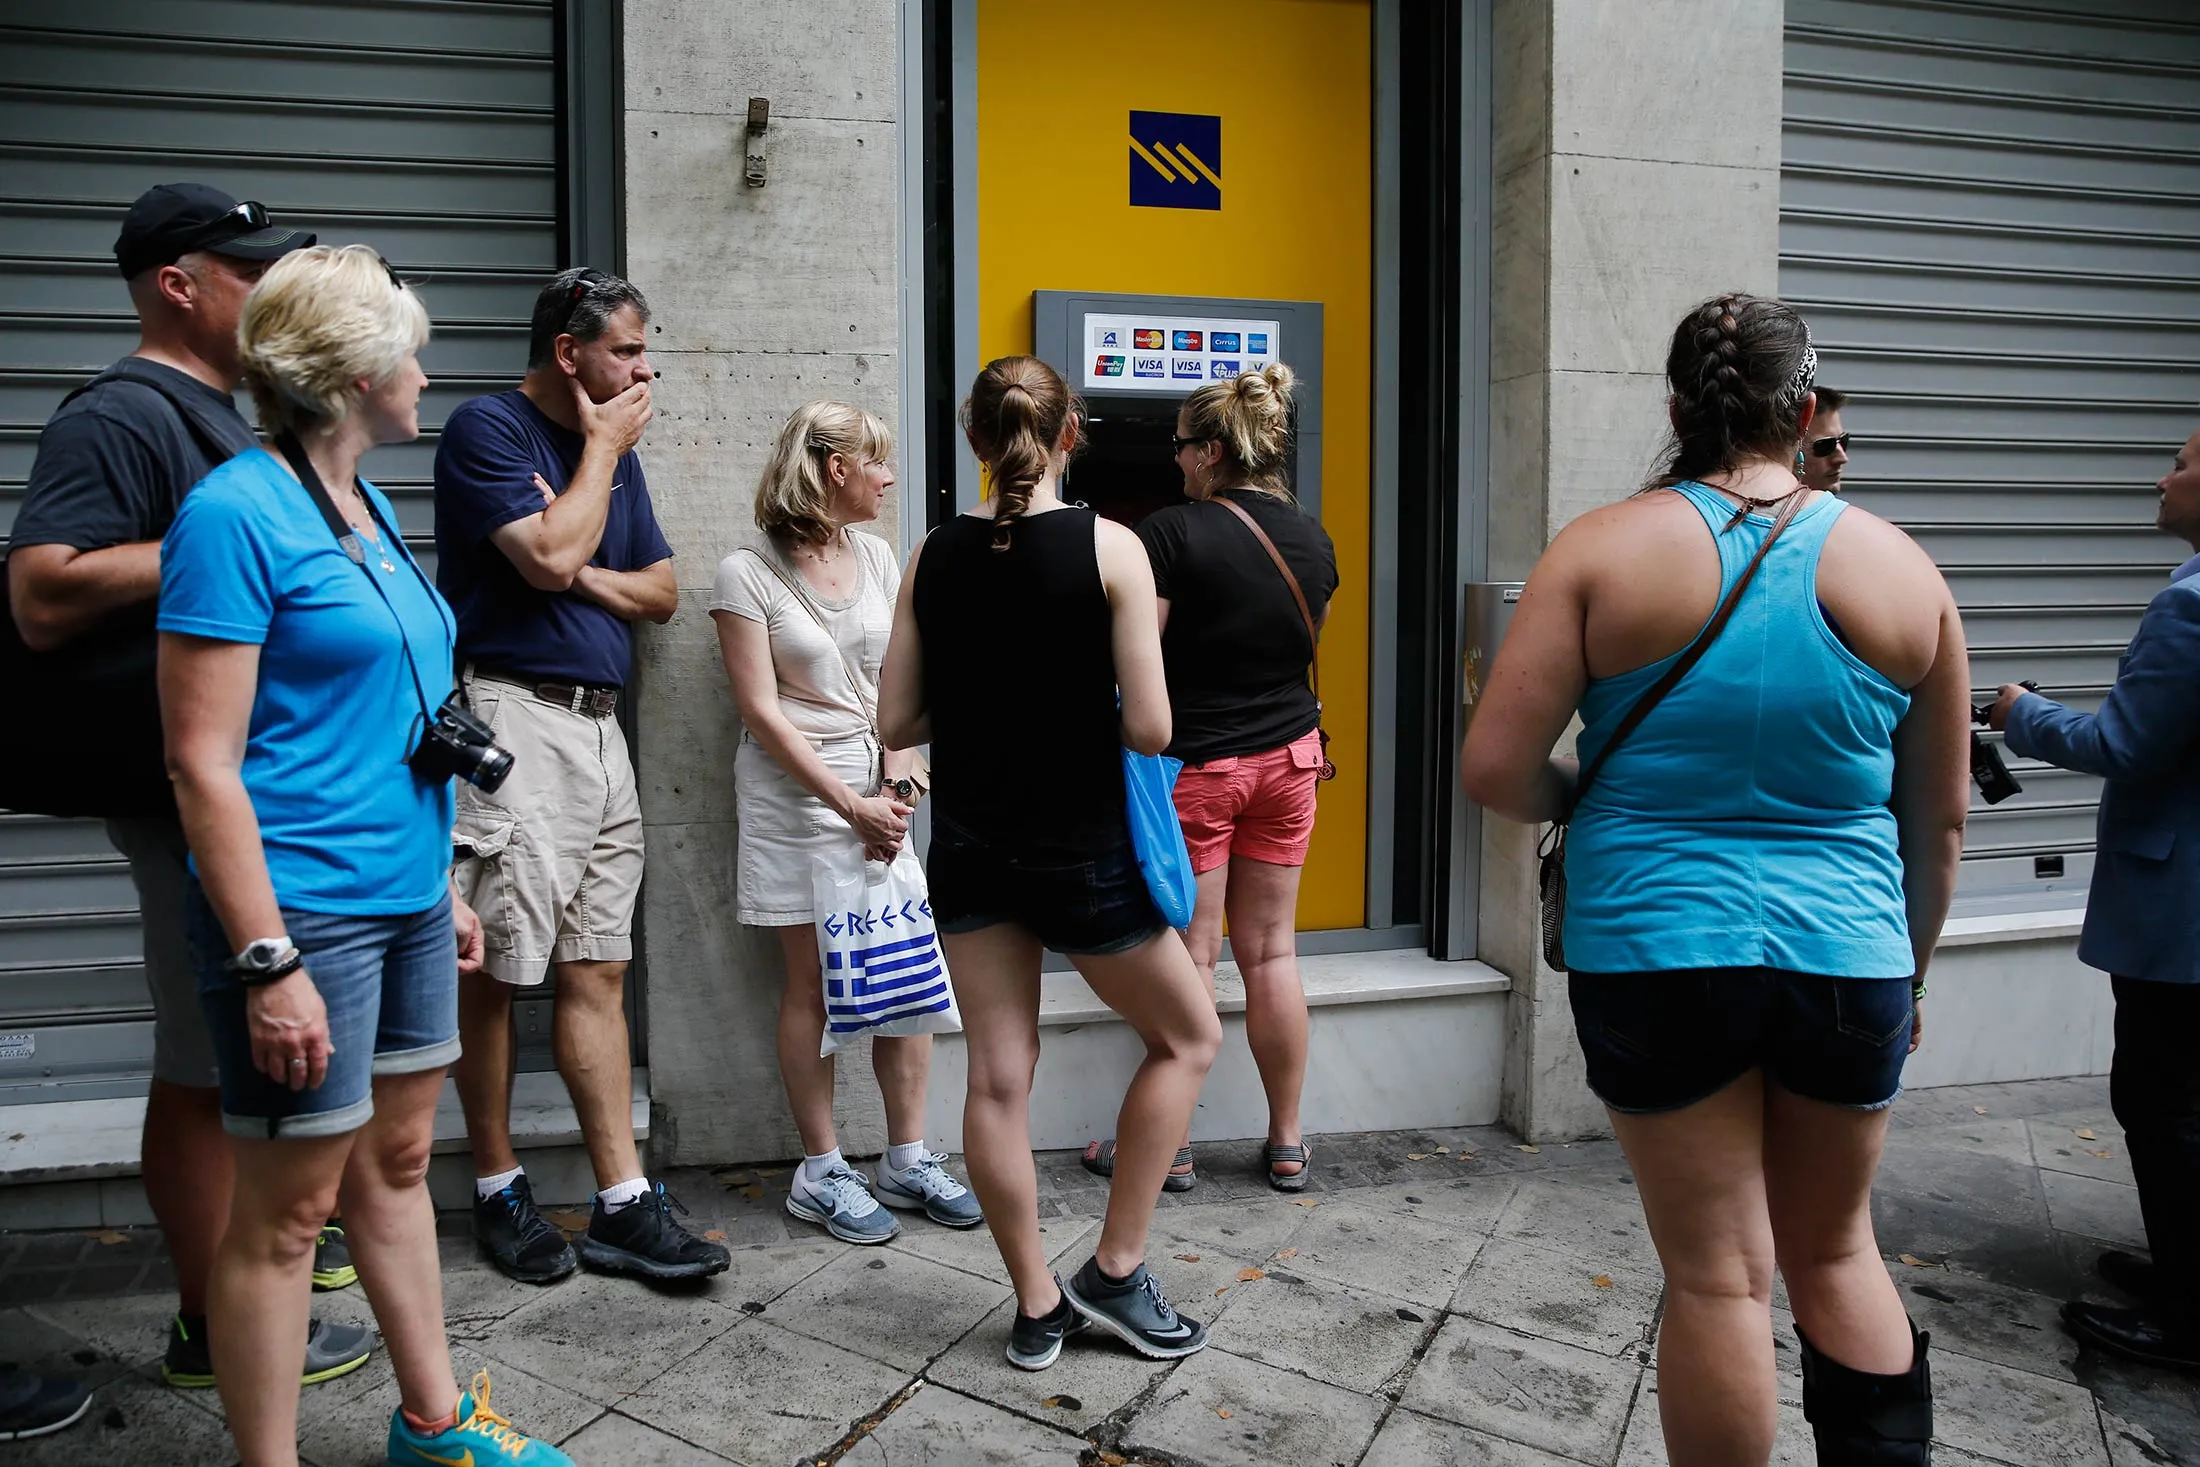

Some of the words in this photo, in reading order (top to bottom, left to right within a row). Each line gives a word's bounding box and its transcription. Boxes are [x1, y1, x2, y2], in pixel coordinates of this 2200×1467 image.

[1177, 337, 1198, 345] Maestro
[1097, 359, 1123, 368] UnionPay
[1138, 359, 1163, 370] VISA
[1177, 361, 1201, 371] VISA
[1219, 369, 1239, 378] PLUS
[823, 899, 933, 938] GREECE
